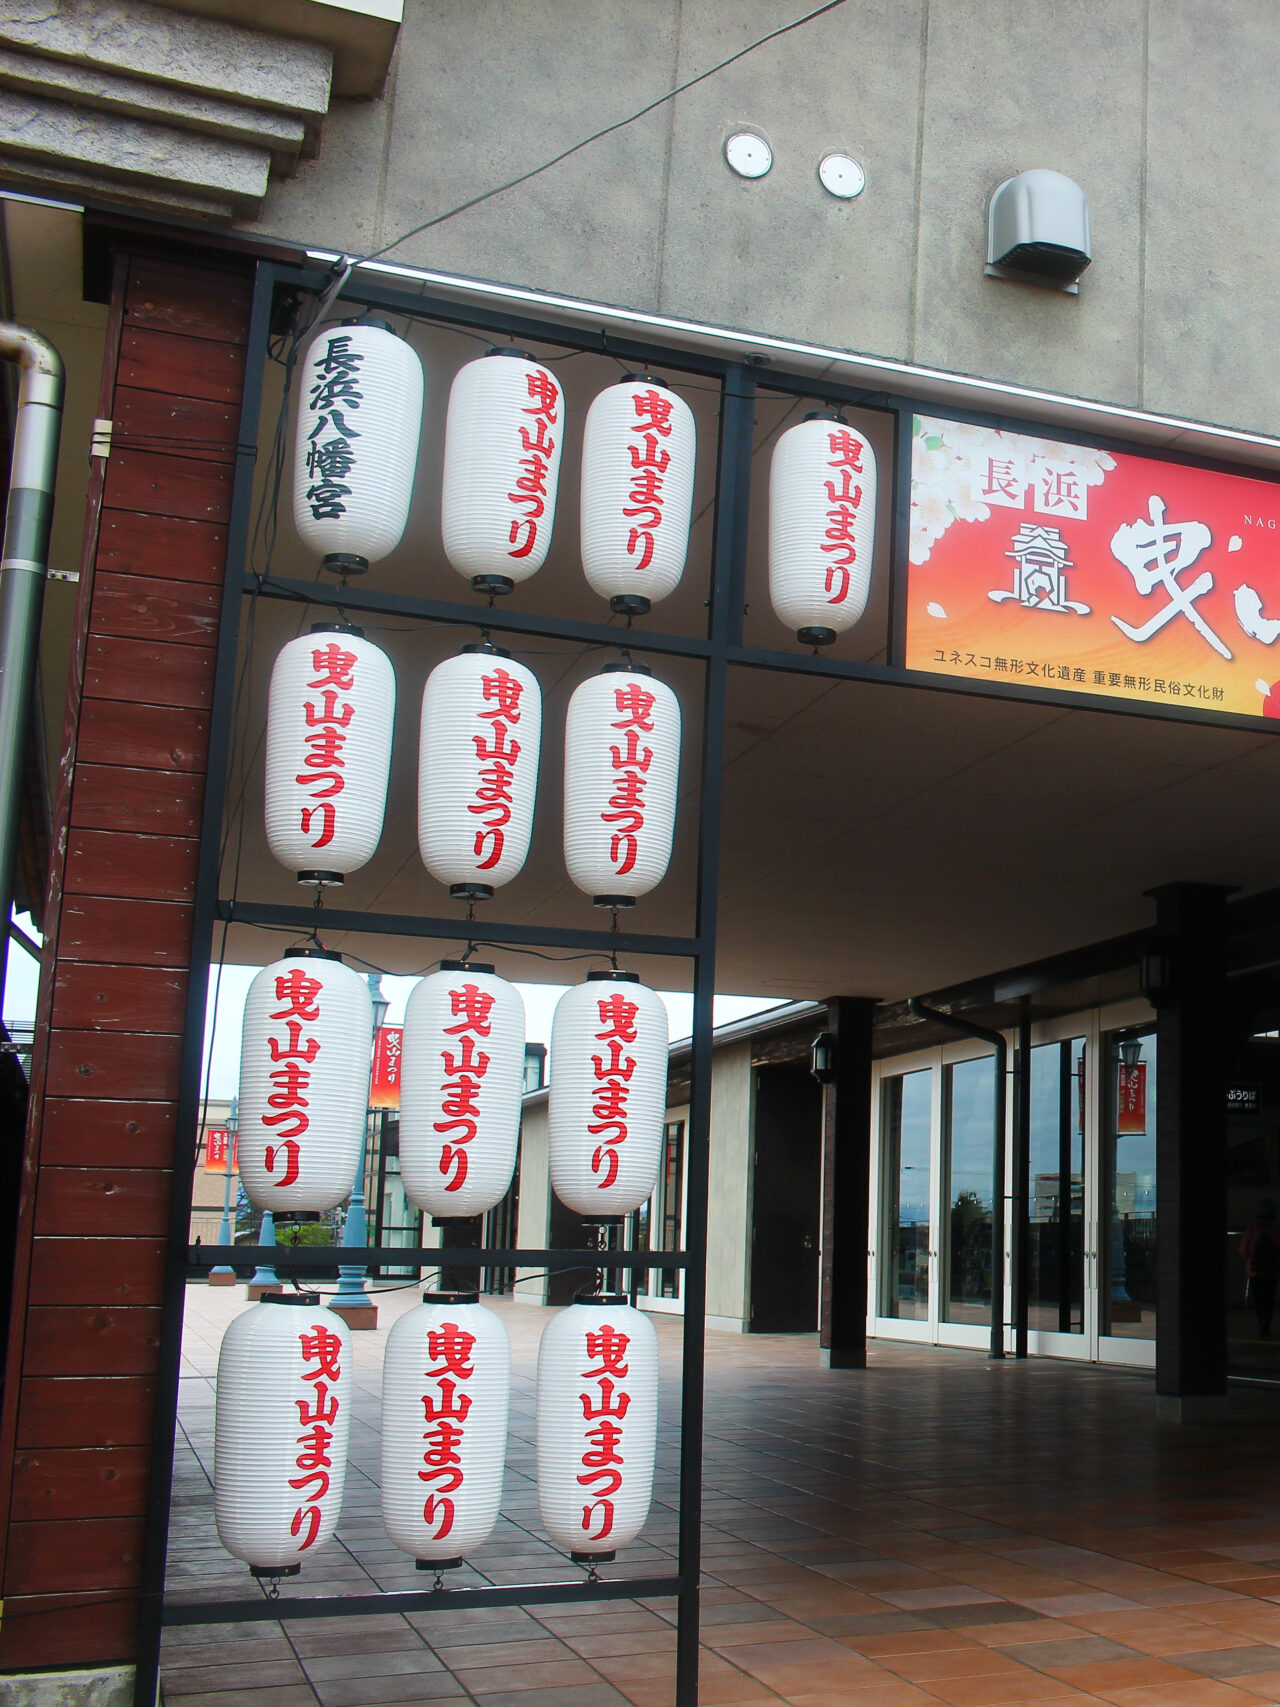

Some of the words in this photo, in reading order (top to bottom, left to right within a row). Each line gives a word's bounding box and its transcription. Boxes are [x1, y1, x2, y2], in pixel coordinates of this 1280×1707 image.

[306, 336, 364, 520] 長浜八幡宮
[508, 370, 558, 558] 曳山まつり
[623, 390, 673, 570] 曳山まつり
[821, 430, 863, 603] 曳山まつり
[980, 457, 1080, 511] 長浜
[296, 644, 358, 848] 曳山まつり
[468, 669, 523, 869] 曳山まつり
[934, 649, 1086, 683] ユネスコ無形文化遺産
[1092, 670, 1225, 702] 重要無形民俗文化財
[602, 684, 656, 875] 曳山まつり
[262, 969, 323, 1186] 曳山まつり
[386, 1031, 401, 1084] 曳山まつり
[434, 984, 495, 1192] 曳山まつり
[588, 994, 639, 1189] 曳山まつり
[289, 1325, 342, 1550] 曳山まつり
[419, 1323, 476, 1540] 曳山まつり
[577, 1325, 631, 1540] 曳山まつり
